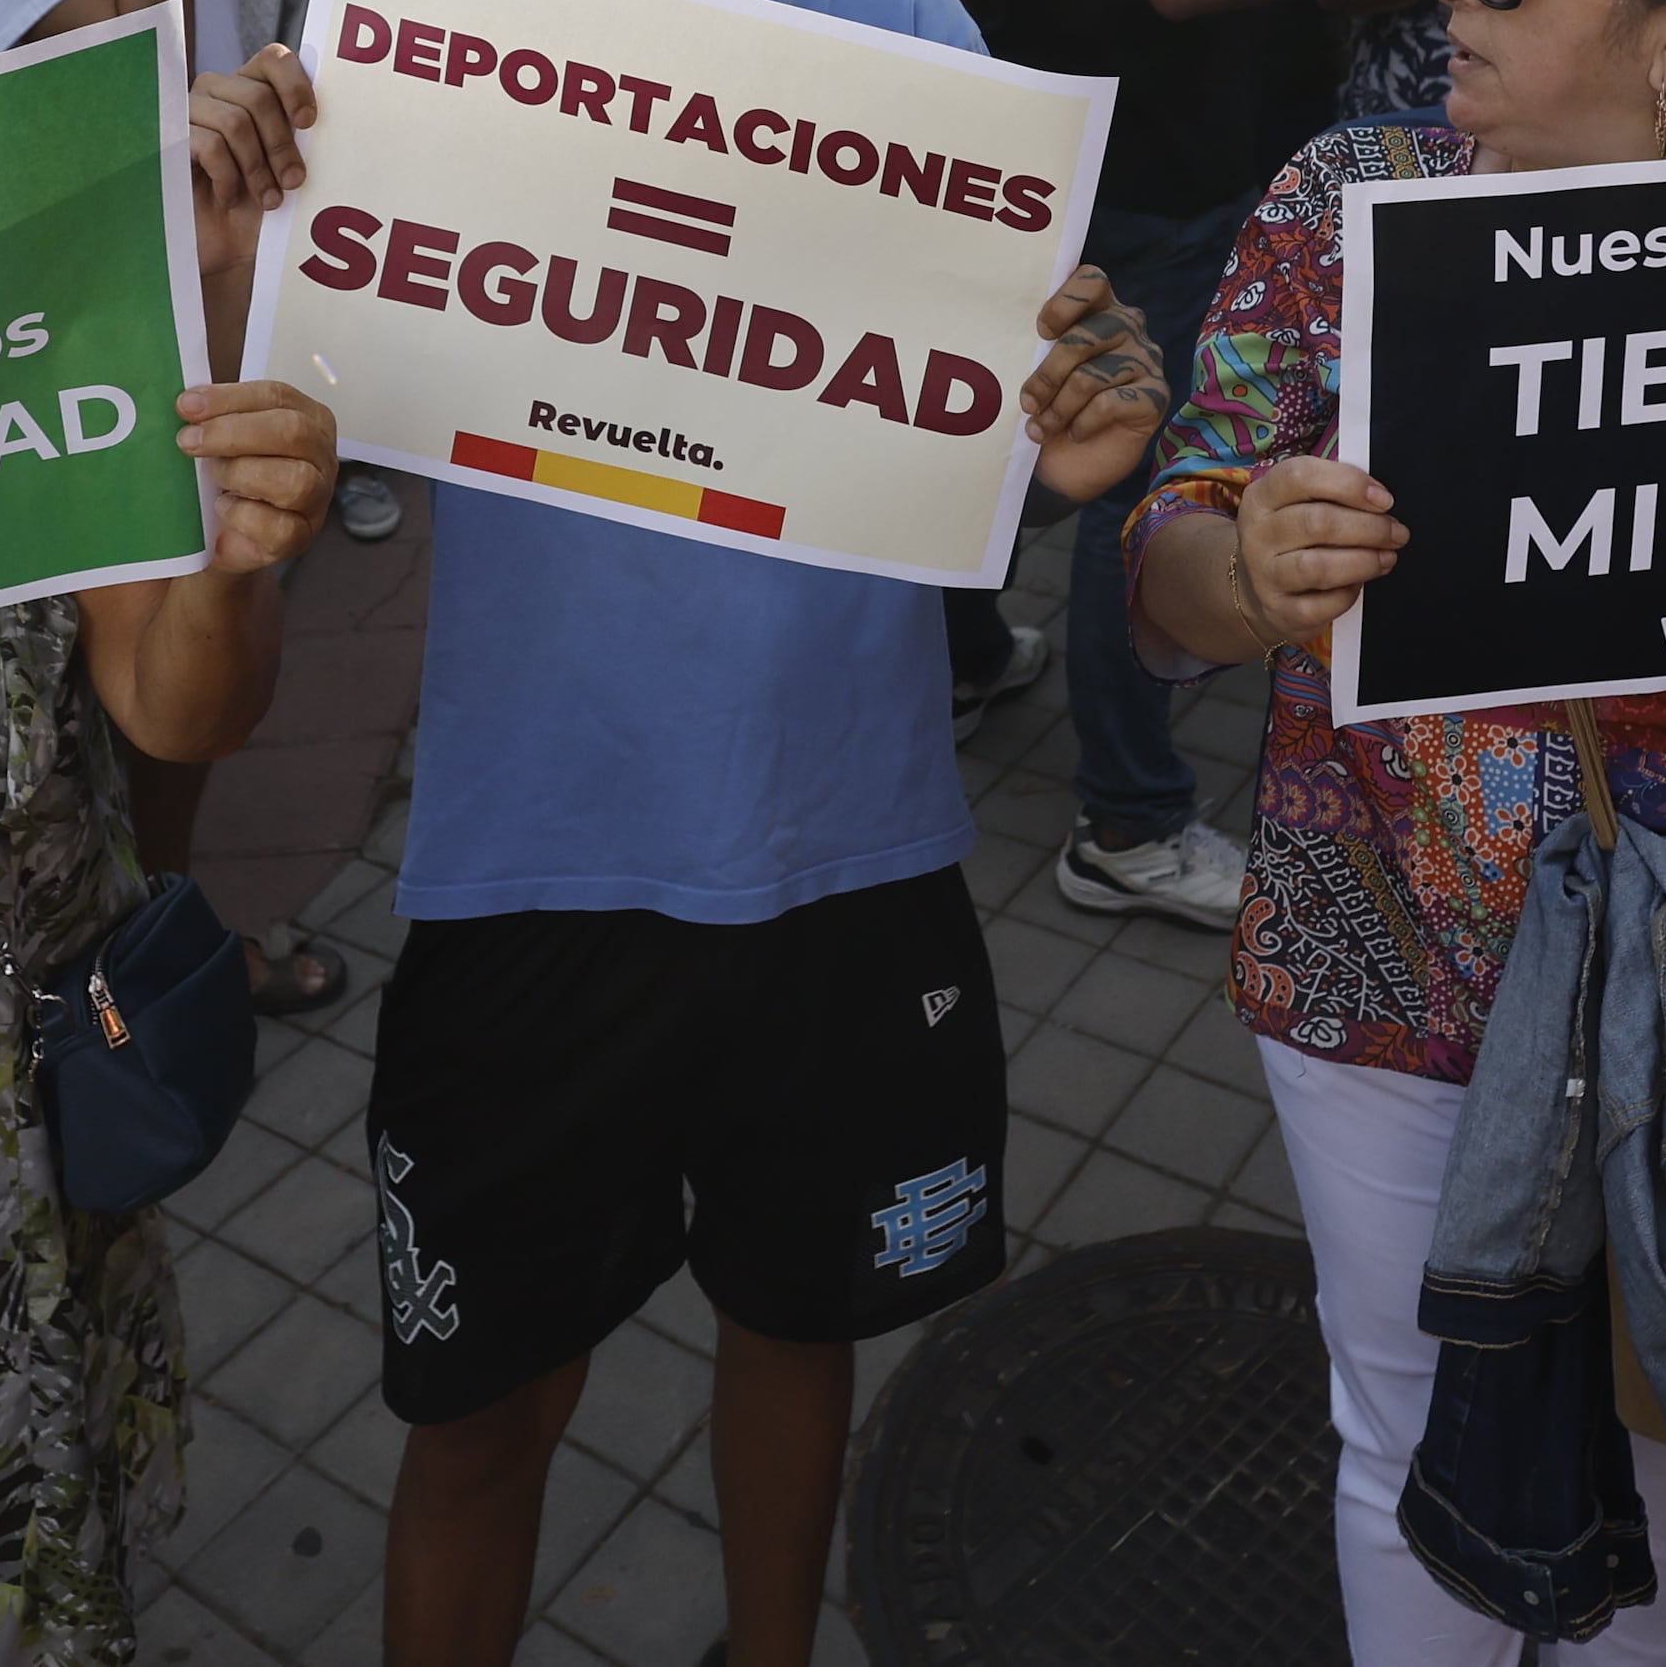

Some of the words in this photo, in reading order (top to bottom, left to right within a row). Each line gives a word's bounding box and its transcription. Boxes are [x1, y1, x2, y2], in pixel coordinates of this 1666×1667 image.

[336, 3, 1057, 233] DEPORTACIONES
[298, 205, 1003, 437] SEGURIDAD
[528, 399, 724, 471] Revuelta.
